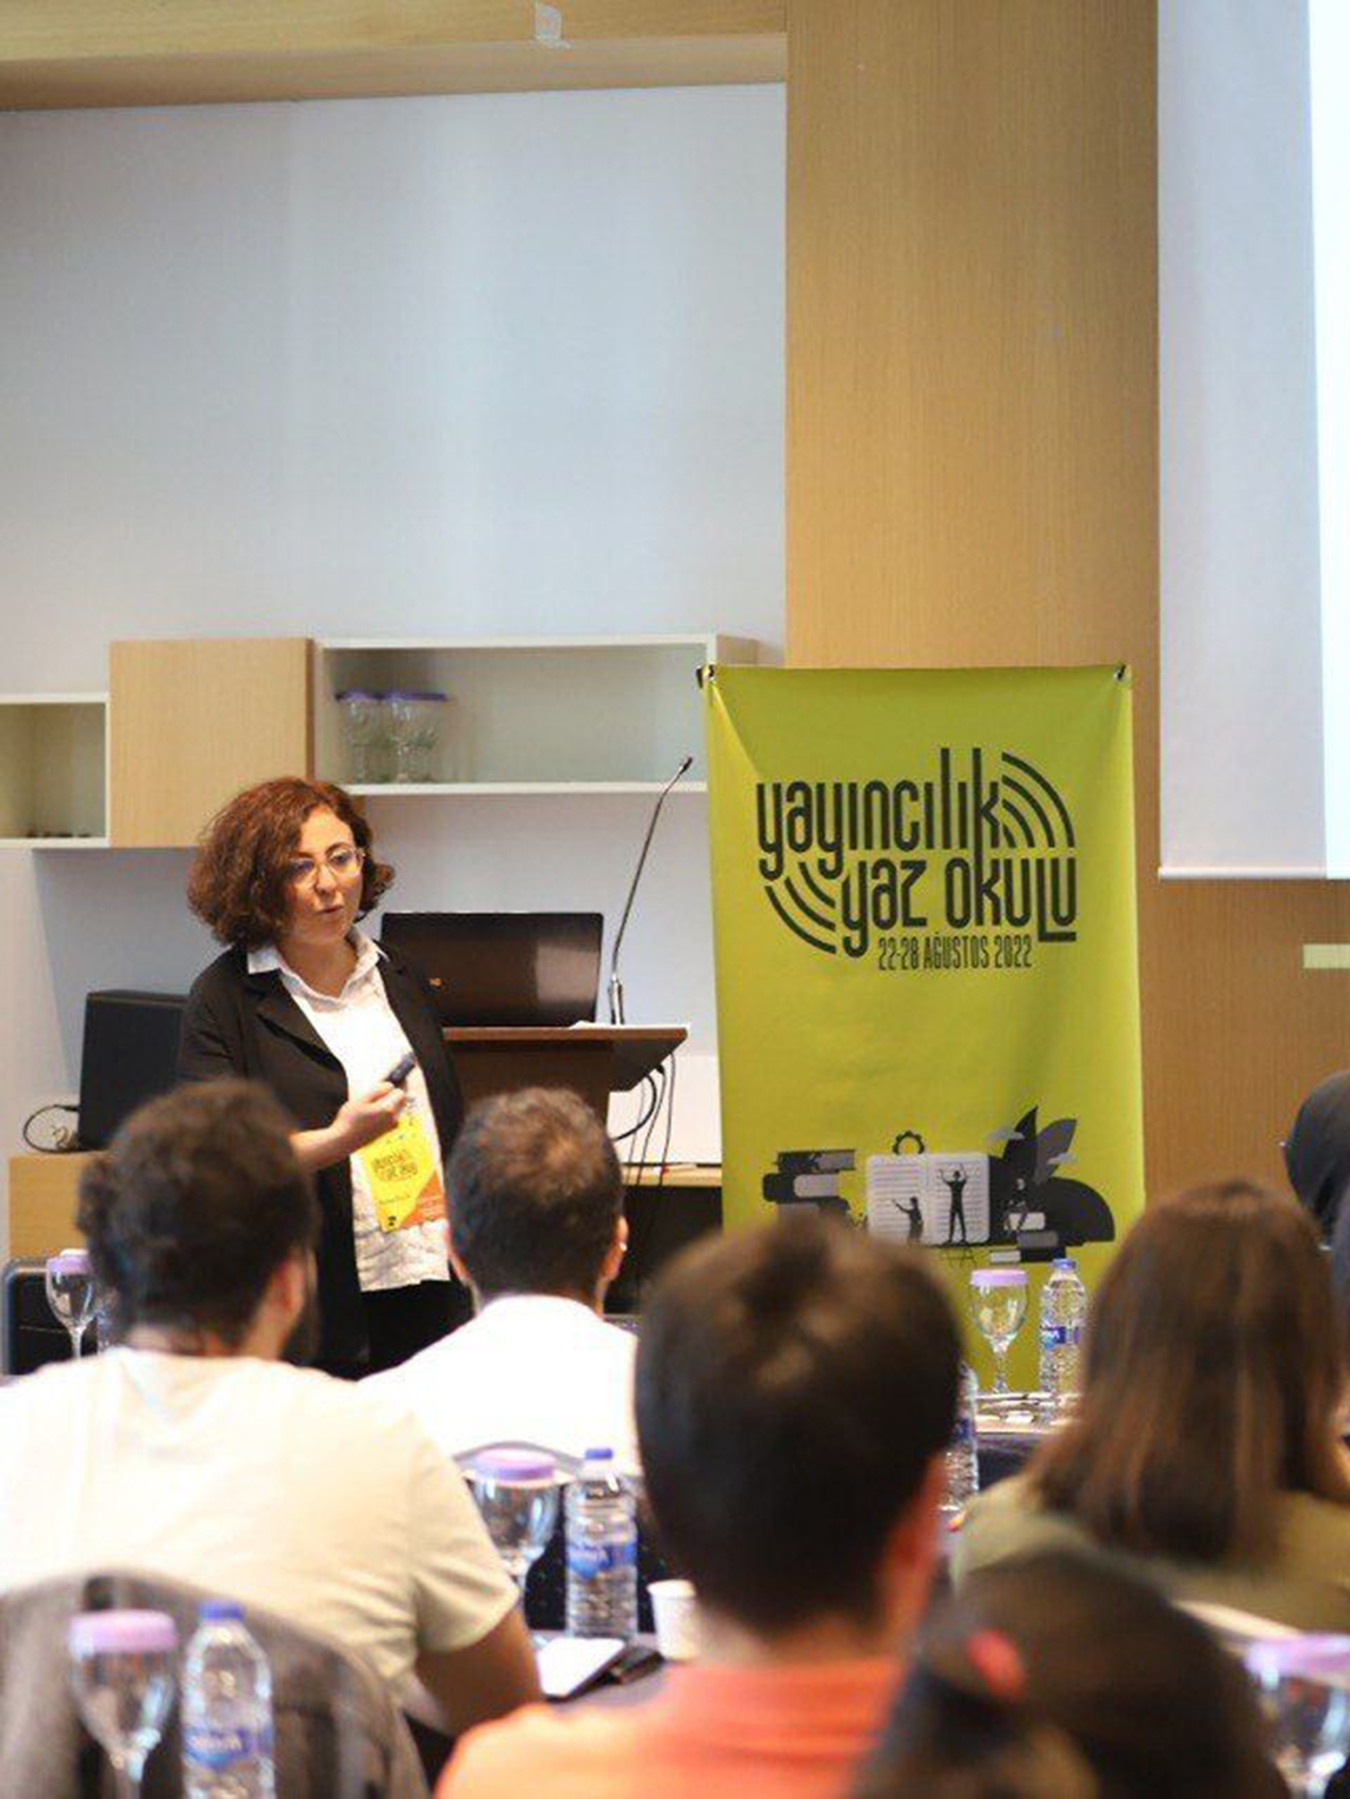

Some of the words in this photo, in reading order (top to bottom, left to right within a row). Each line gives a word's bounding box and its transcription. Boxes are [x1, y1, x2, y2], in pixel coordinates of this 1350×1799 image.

[756, 747, 1000, 881] yayıncılık
[841, 857, 928, 958] yaz
[878, 936, 919, 971] 22-28
[922, 931, 990, 970] AĞUSTOS
[993, 933, 1033, 969] 2022
